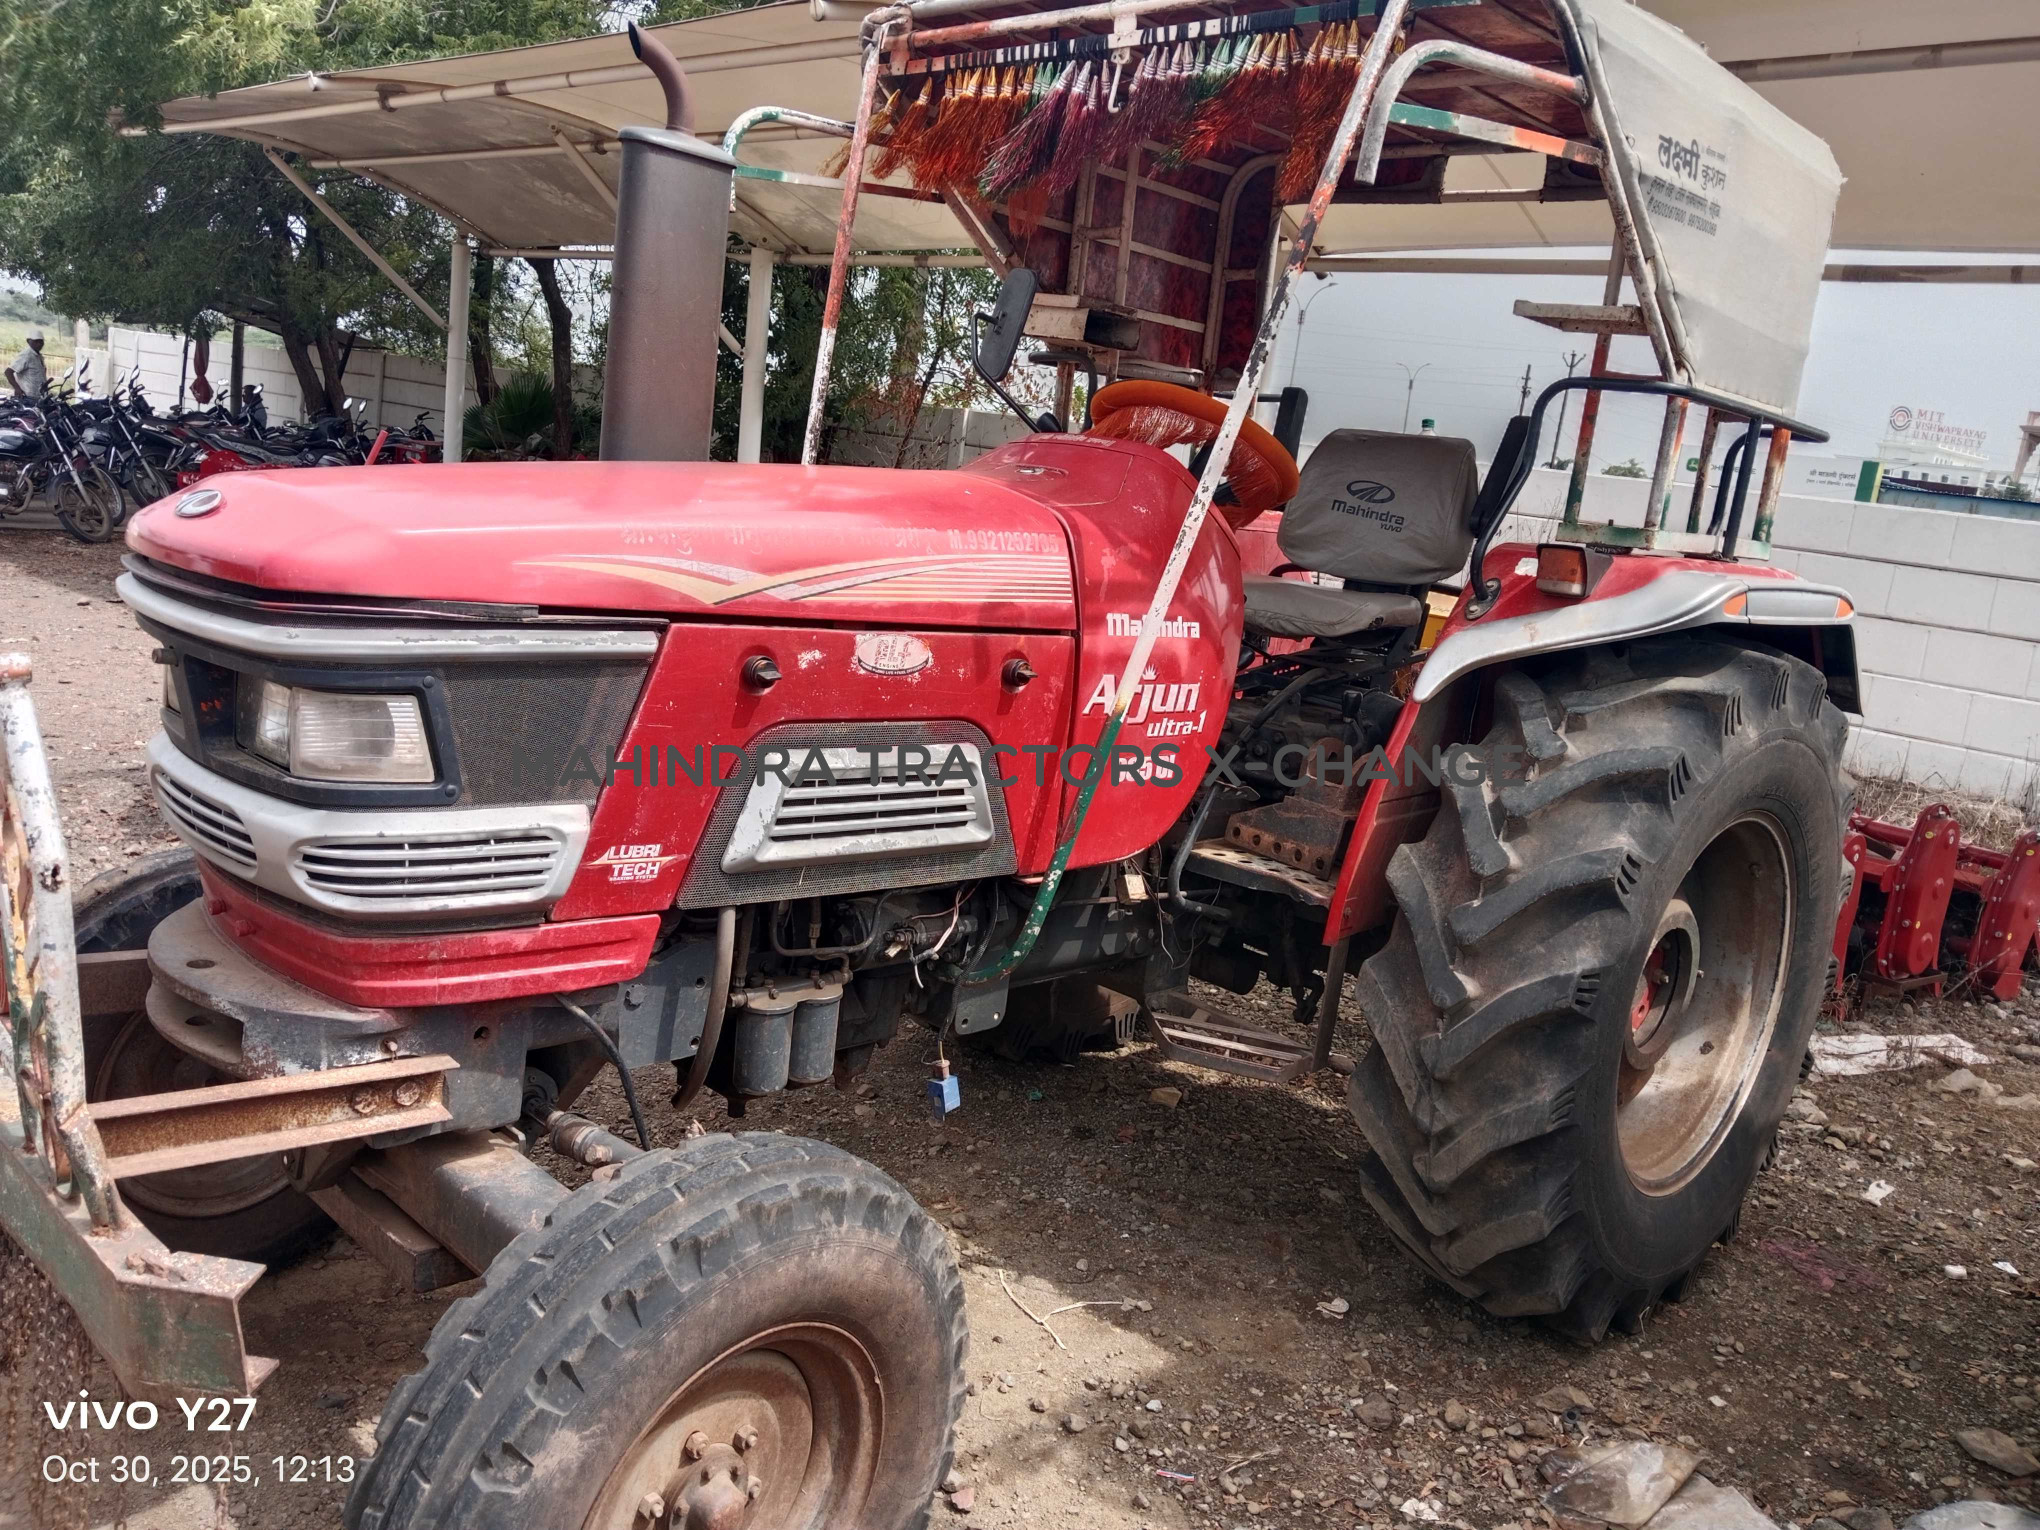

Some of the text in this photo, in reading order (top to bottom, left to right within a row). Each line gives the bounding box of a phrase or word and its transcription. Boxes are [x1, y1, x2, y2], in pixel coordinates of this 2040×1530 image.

[1917, 408, 1945, 423] MIT
[1913, 431, 1985, 449] UNIVERSITY
[1915, 421, 1987, 440] VISHWAPRAYAG
[1331, 500, 1405, 525] Mahindra
[1106, 612, 1200, 638] Mandra
[1082, 673, 1201, 725] Arjun
[1146, 710, 1207, 738] ultra-1
[608, 844, 661, 859] LUBRI
[612, 862, 660, 876] TECH
